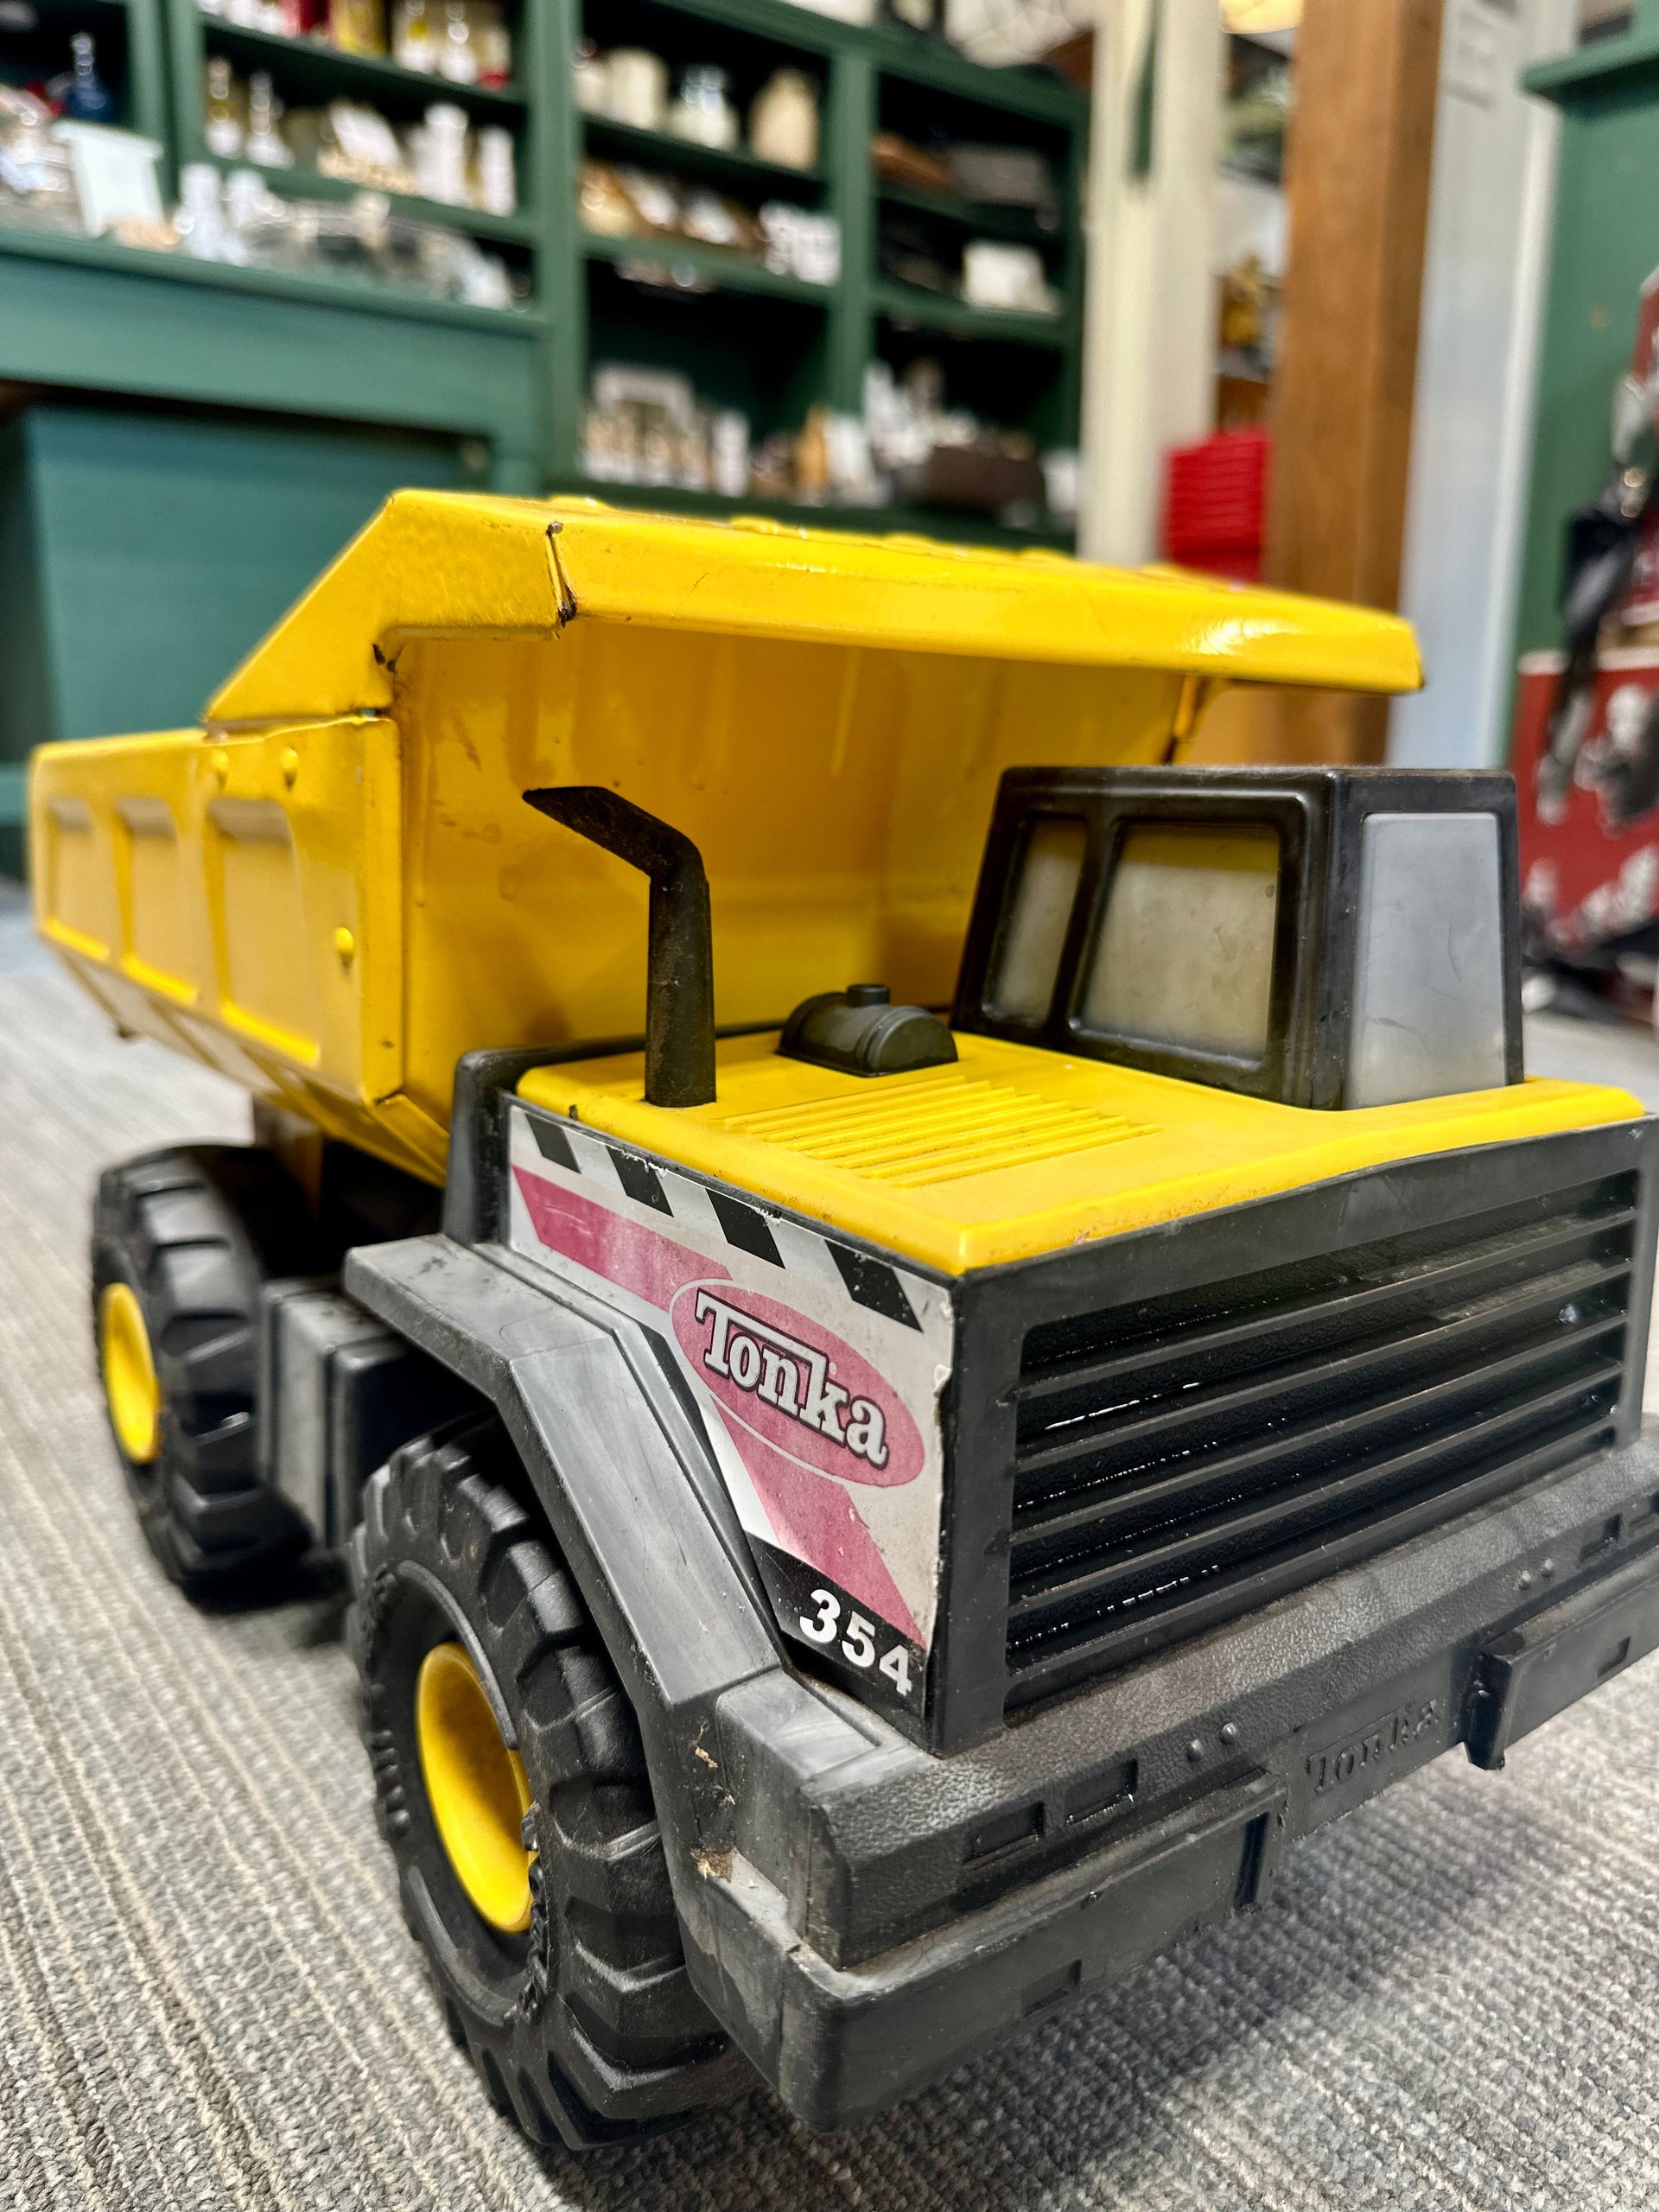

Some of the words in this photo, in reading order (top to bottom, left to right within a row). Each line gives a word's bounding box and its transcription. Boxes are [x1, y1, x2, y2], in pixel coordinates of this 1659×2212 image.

[695, 1288, 890, 1470] Tonka
[798, 1588, 912, 1696] 354
[1304, 1699, 1441, 1793] Tonka
